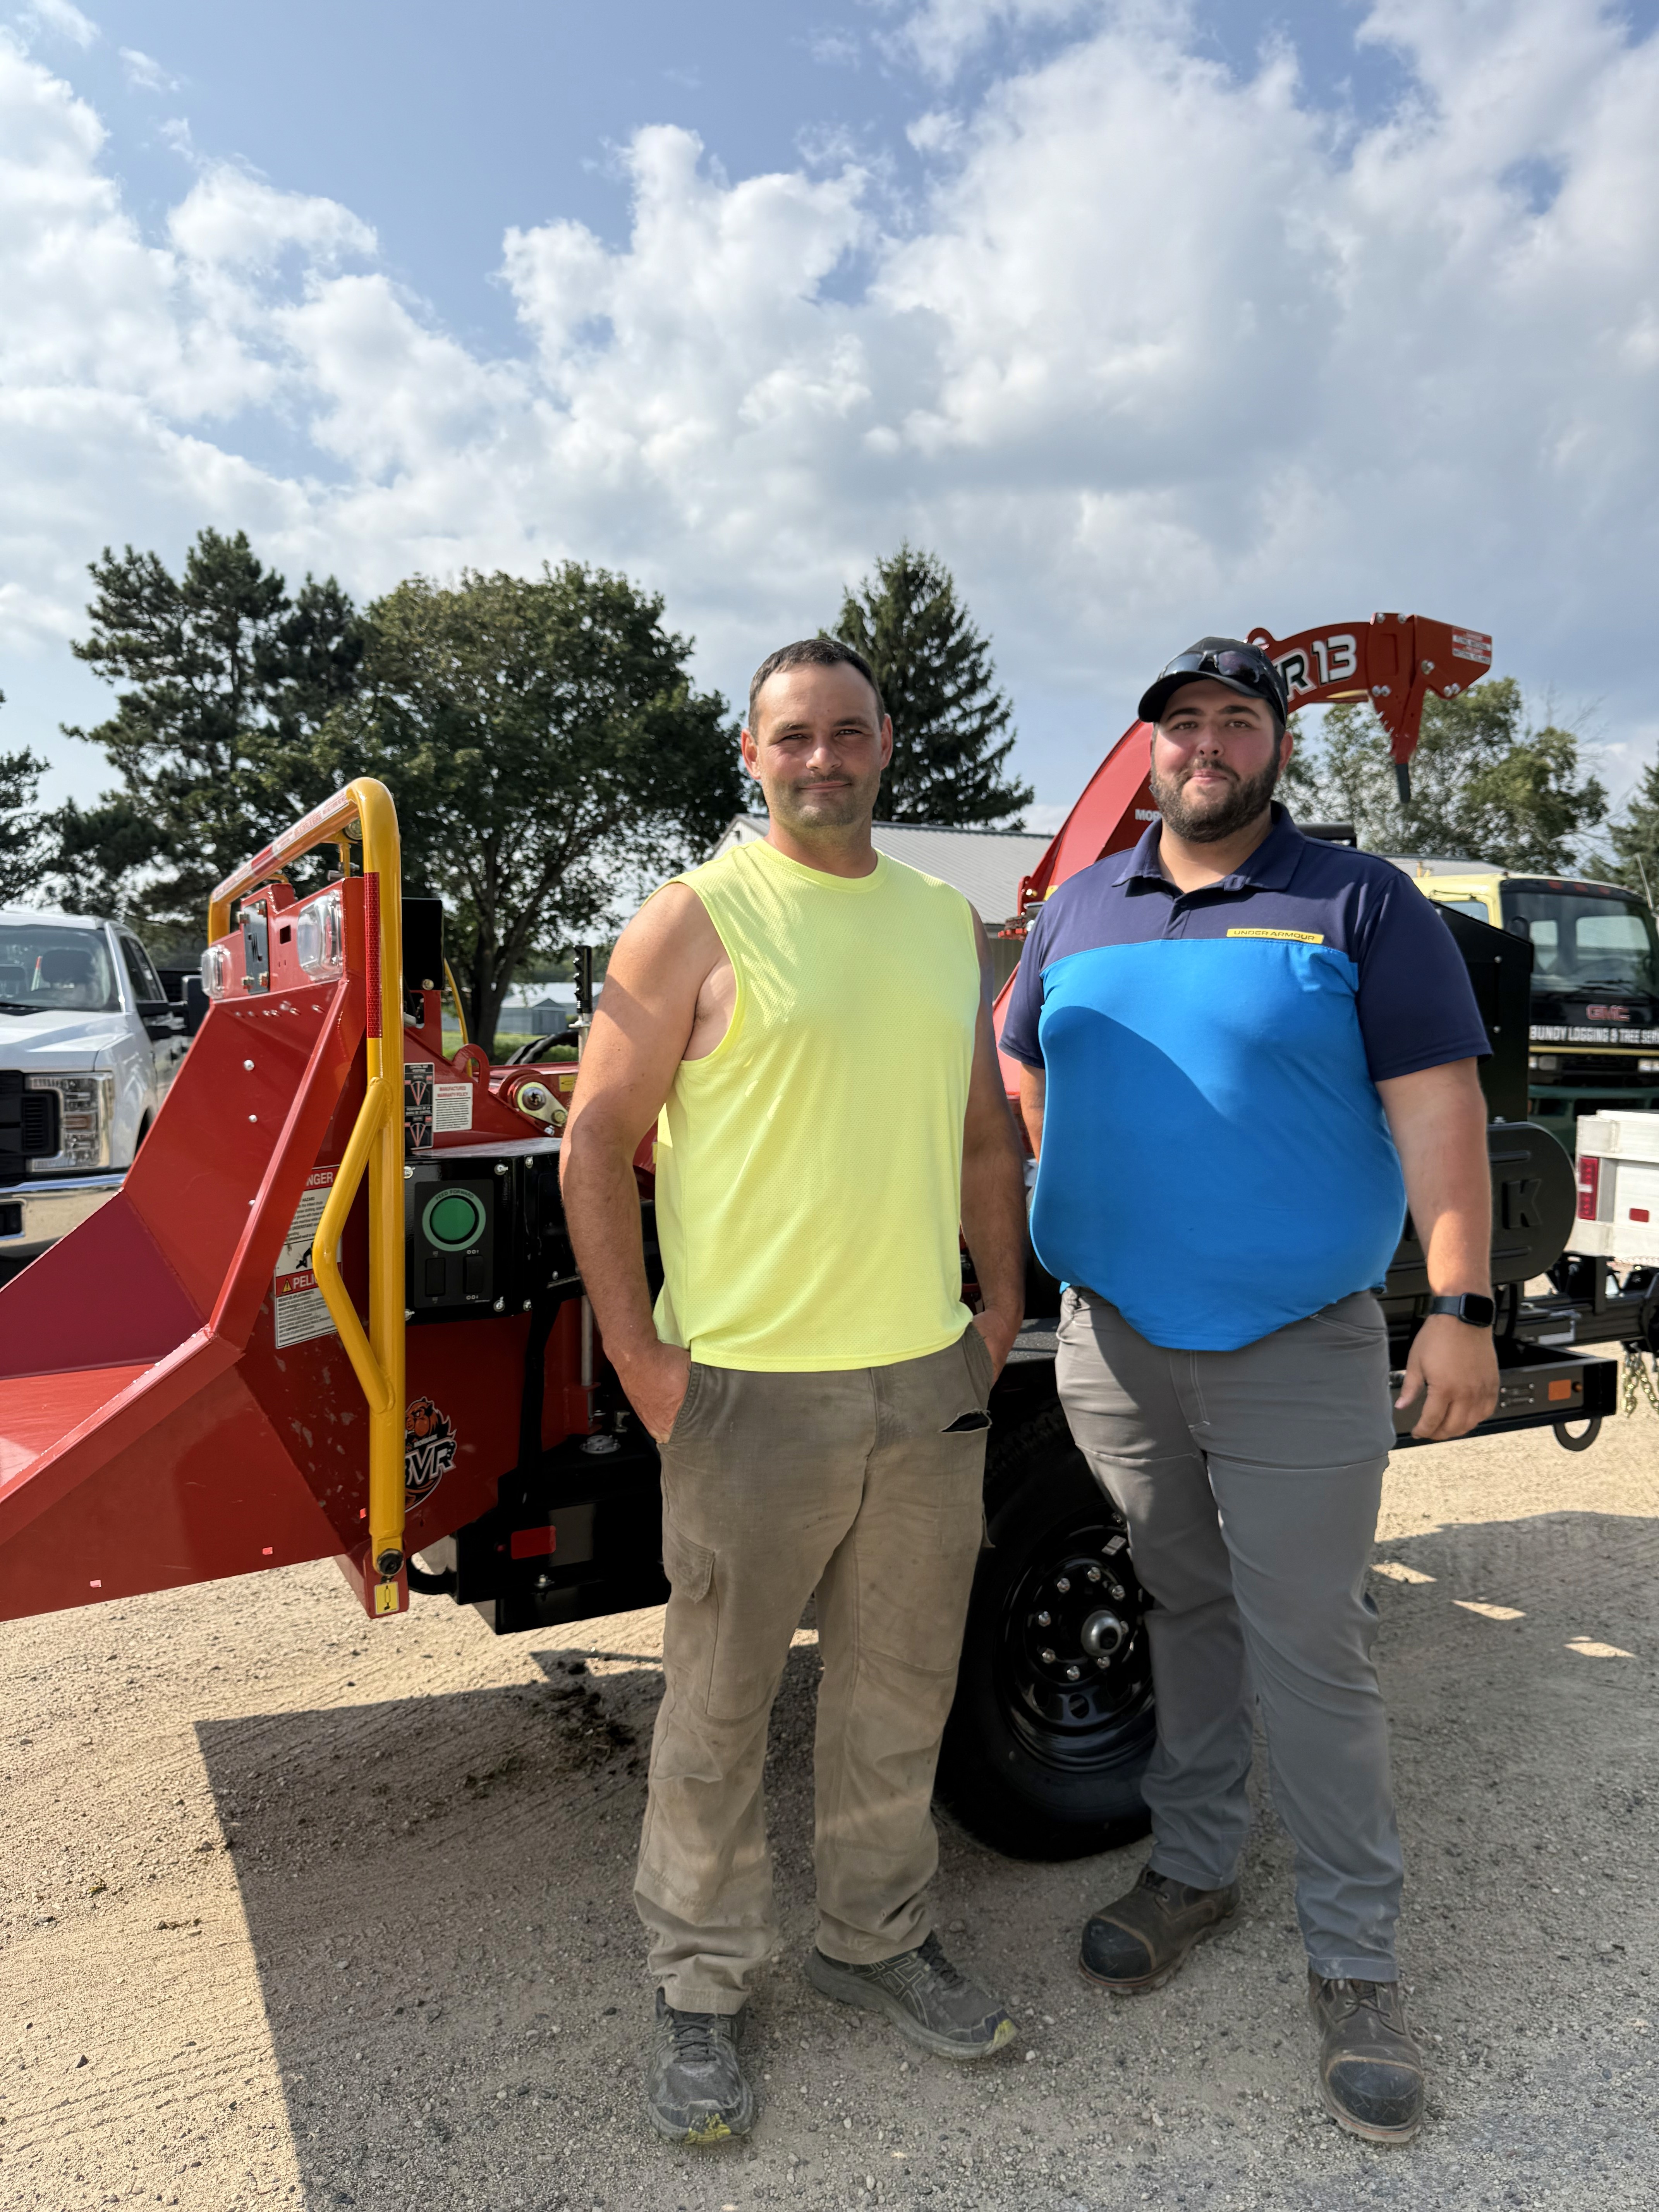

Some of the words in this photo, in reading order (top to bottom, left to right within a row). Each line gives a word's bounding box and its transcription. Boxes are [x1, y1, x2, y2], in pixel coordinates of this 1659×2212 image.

[1270, 932, 1315, 941] ARMOUR
[1586, 1004, 1630, 1022] GMC
[1528, 1024, 1567, 1041] BUNDY
[1568, 1026, 1609, 1042] LOGGING
[306, 1172, 333, 1186] NGER
[436, 1191, 448, 1200] FEED
[450, 1189, 474, 1199] FORWARD
[293, 1274, 318, 1289] PELI
